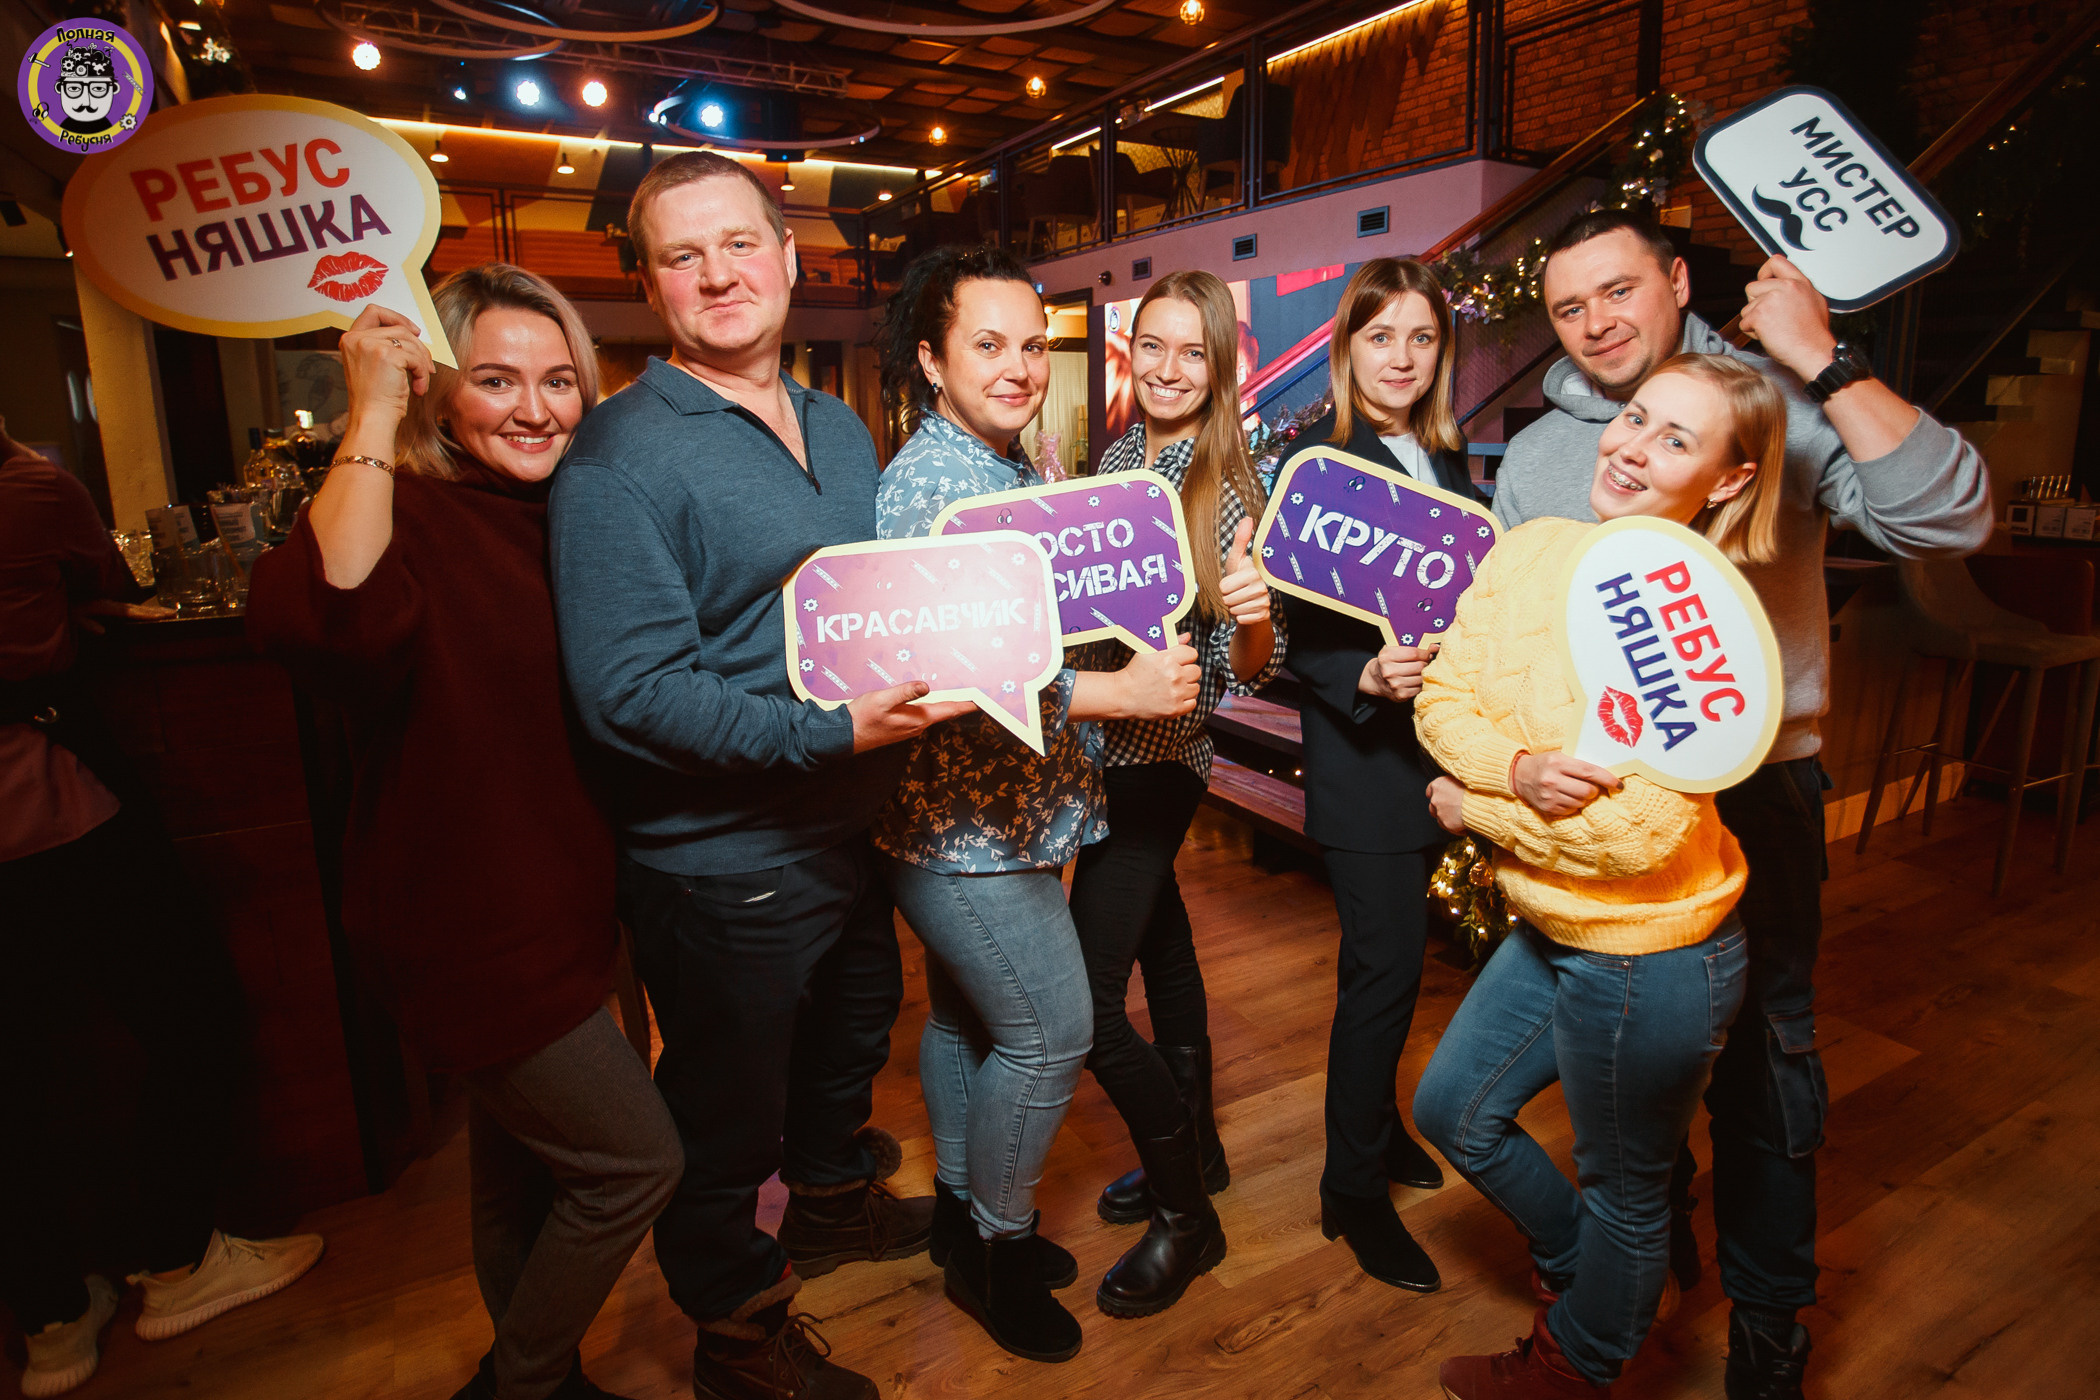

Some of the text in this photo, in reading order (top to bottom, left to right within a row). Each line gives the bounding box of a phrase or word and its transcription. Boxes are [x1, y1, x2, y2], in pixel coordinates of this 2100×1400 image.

[129, 138, 351, 222] РЕБУС
[1778, 166, 1848, 232] УСС
[1789, 116, 1920, 239] МИСТЕР
[145, 193, 392, 281] НЯШКА
[1298, 504, 1455, 590] КРУТО
[816, 597, 1027, 643] КРАСАВЧИК
[1595, 572, 1697, 752] НЯШКА
[1644, 560, 1746, 723] РЕБУС
